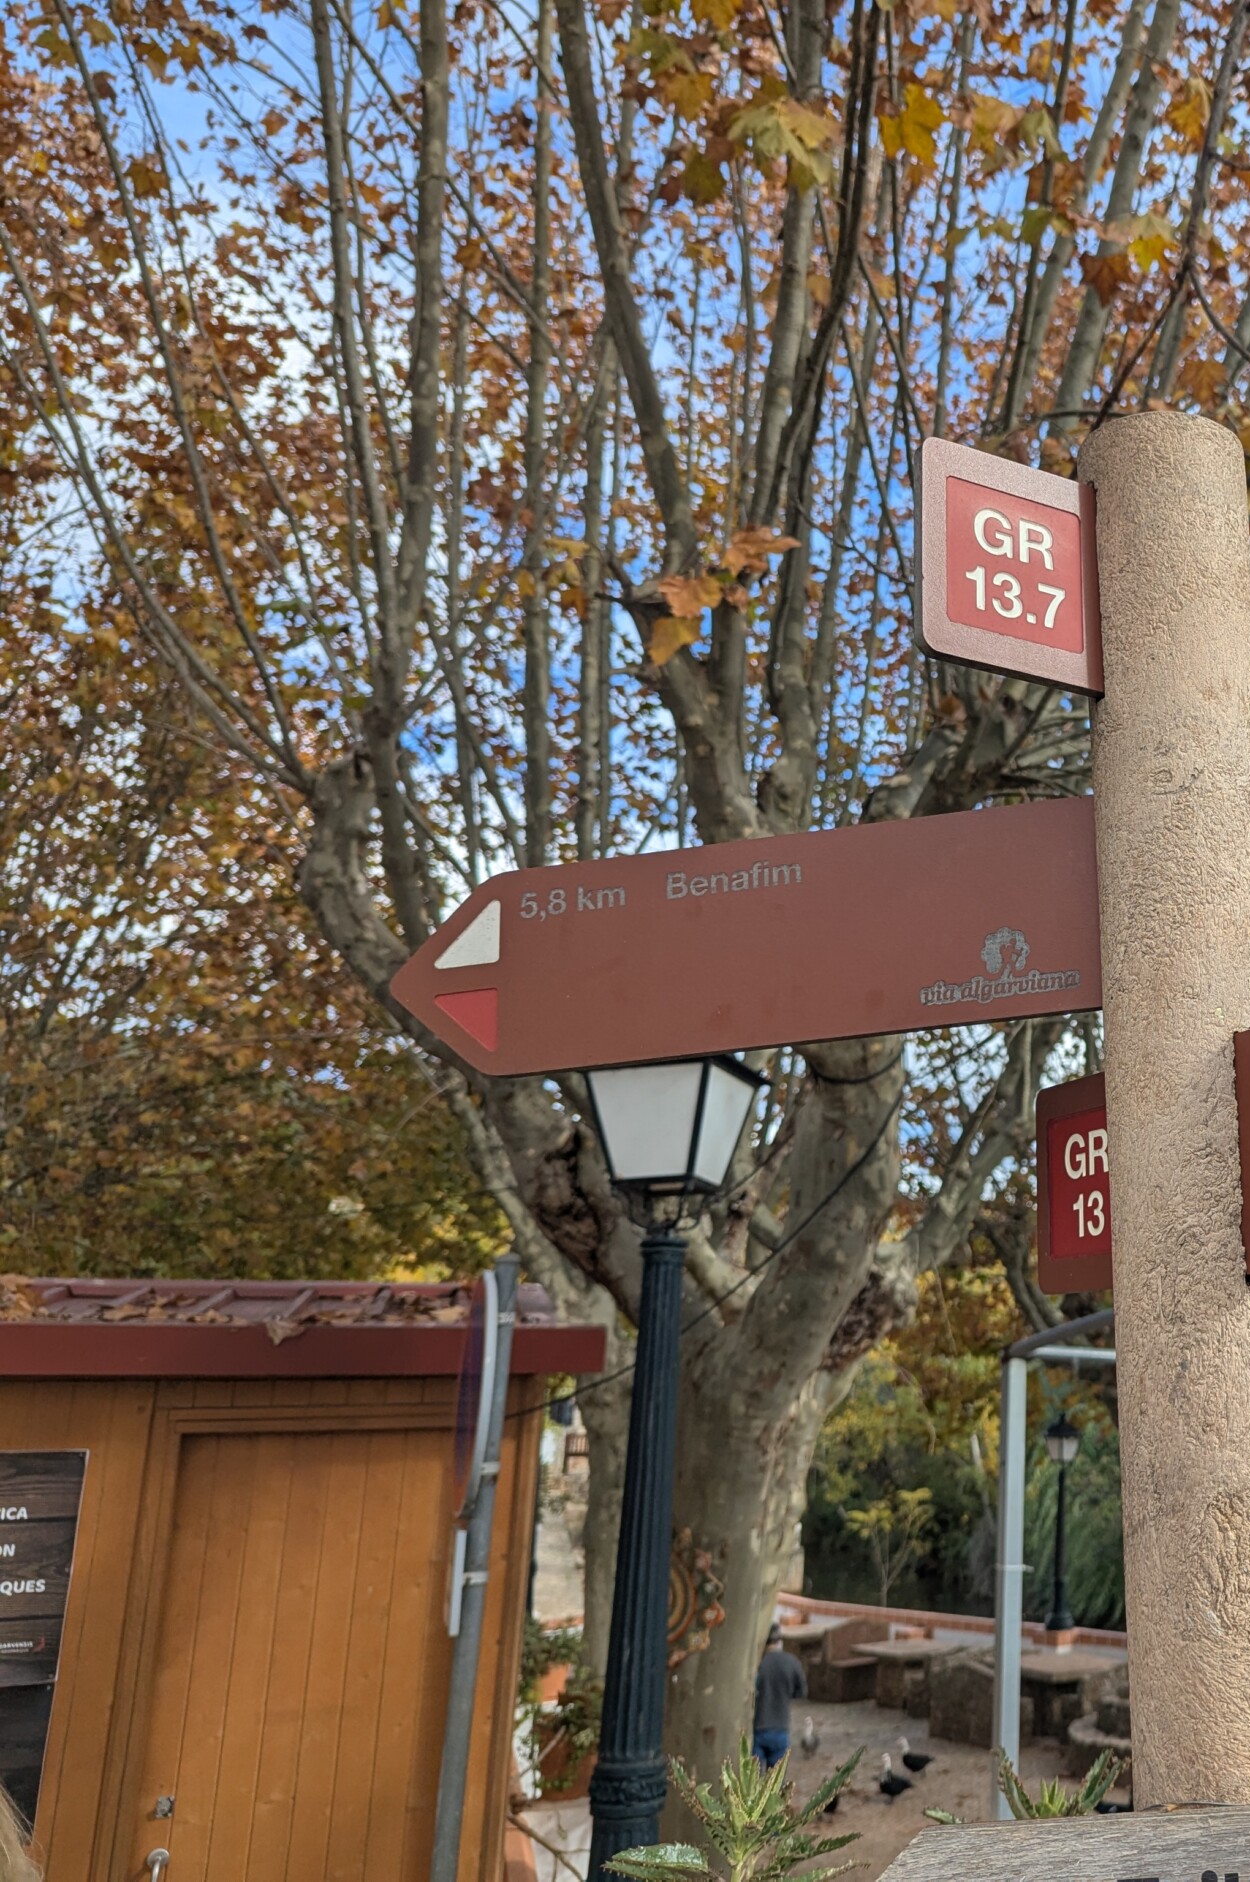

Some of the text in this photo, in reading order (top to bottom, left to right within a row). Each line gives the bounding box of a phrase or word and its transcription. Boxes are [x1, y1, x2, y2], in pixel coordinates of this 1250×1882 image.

[973, 507, 1055, 571] GR
[965, 565, 1066, 630] 13.7
[519, 861, 802, 922] 5,8 km Benafim
[1064, 1128, 1110, 1180] GR
[1072, 1190, 1106, 1238] 13
[0, 1506, 28, 1520] ICA
